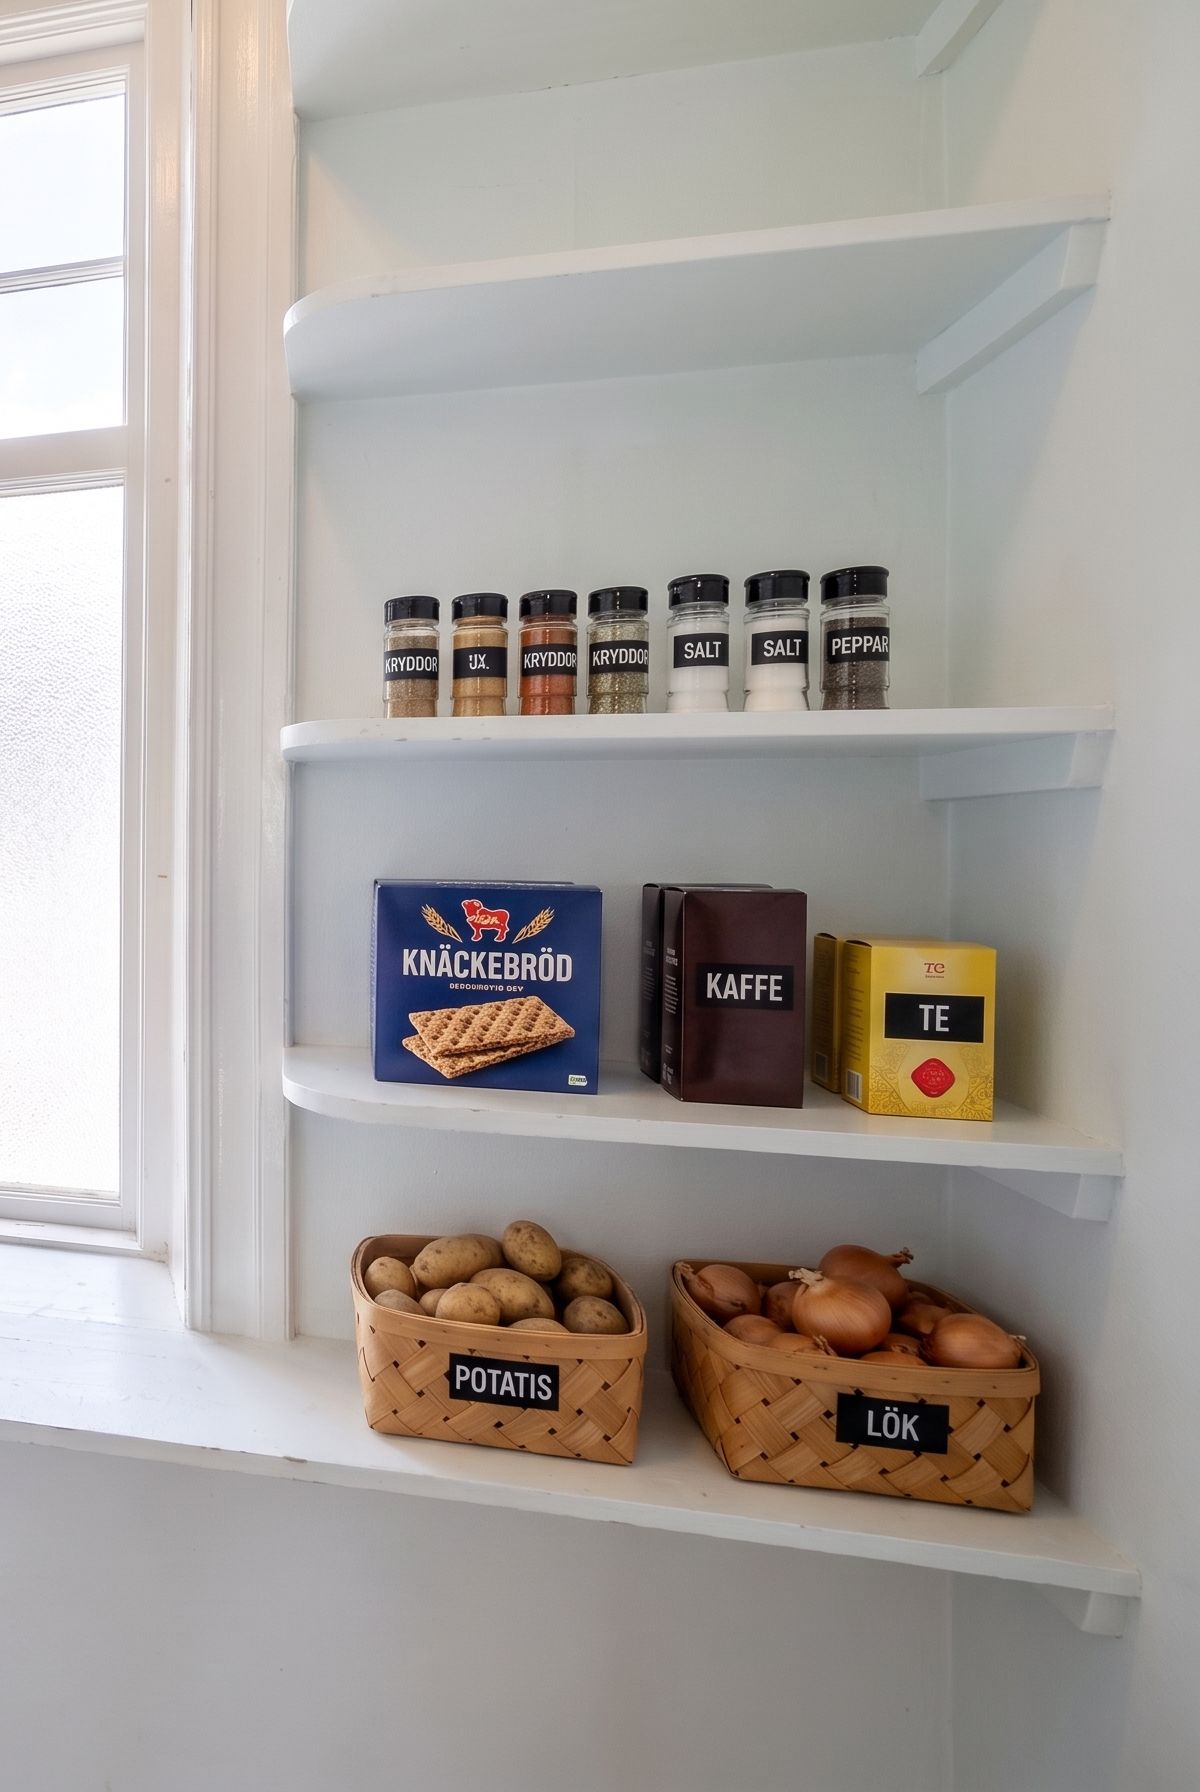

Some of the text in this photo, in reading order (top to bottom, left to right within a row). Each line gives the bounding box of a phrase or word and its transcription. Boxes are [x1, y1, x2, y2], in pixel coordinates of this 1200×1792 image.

[683, 641, 722, 660] SALT
[763, 639, 802, 658] SALT
[831, 635, 889, 656] PEPPAR
[385, 656, 438, 674] KRYDDOR
[524, 651, 577, 669] KRYDDOR
[592, 648, 648, 667] KRYDDOR
[402, 943, 573, 982] KNÄCKEBRÖD
[706, 972, 783, 1002] KAFFE
[918, 1004, 950, 1033] TE
[455, 1364, 553, 1401] POTATIS
[867, 1405, 920, 1442] LÖK
